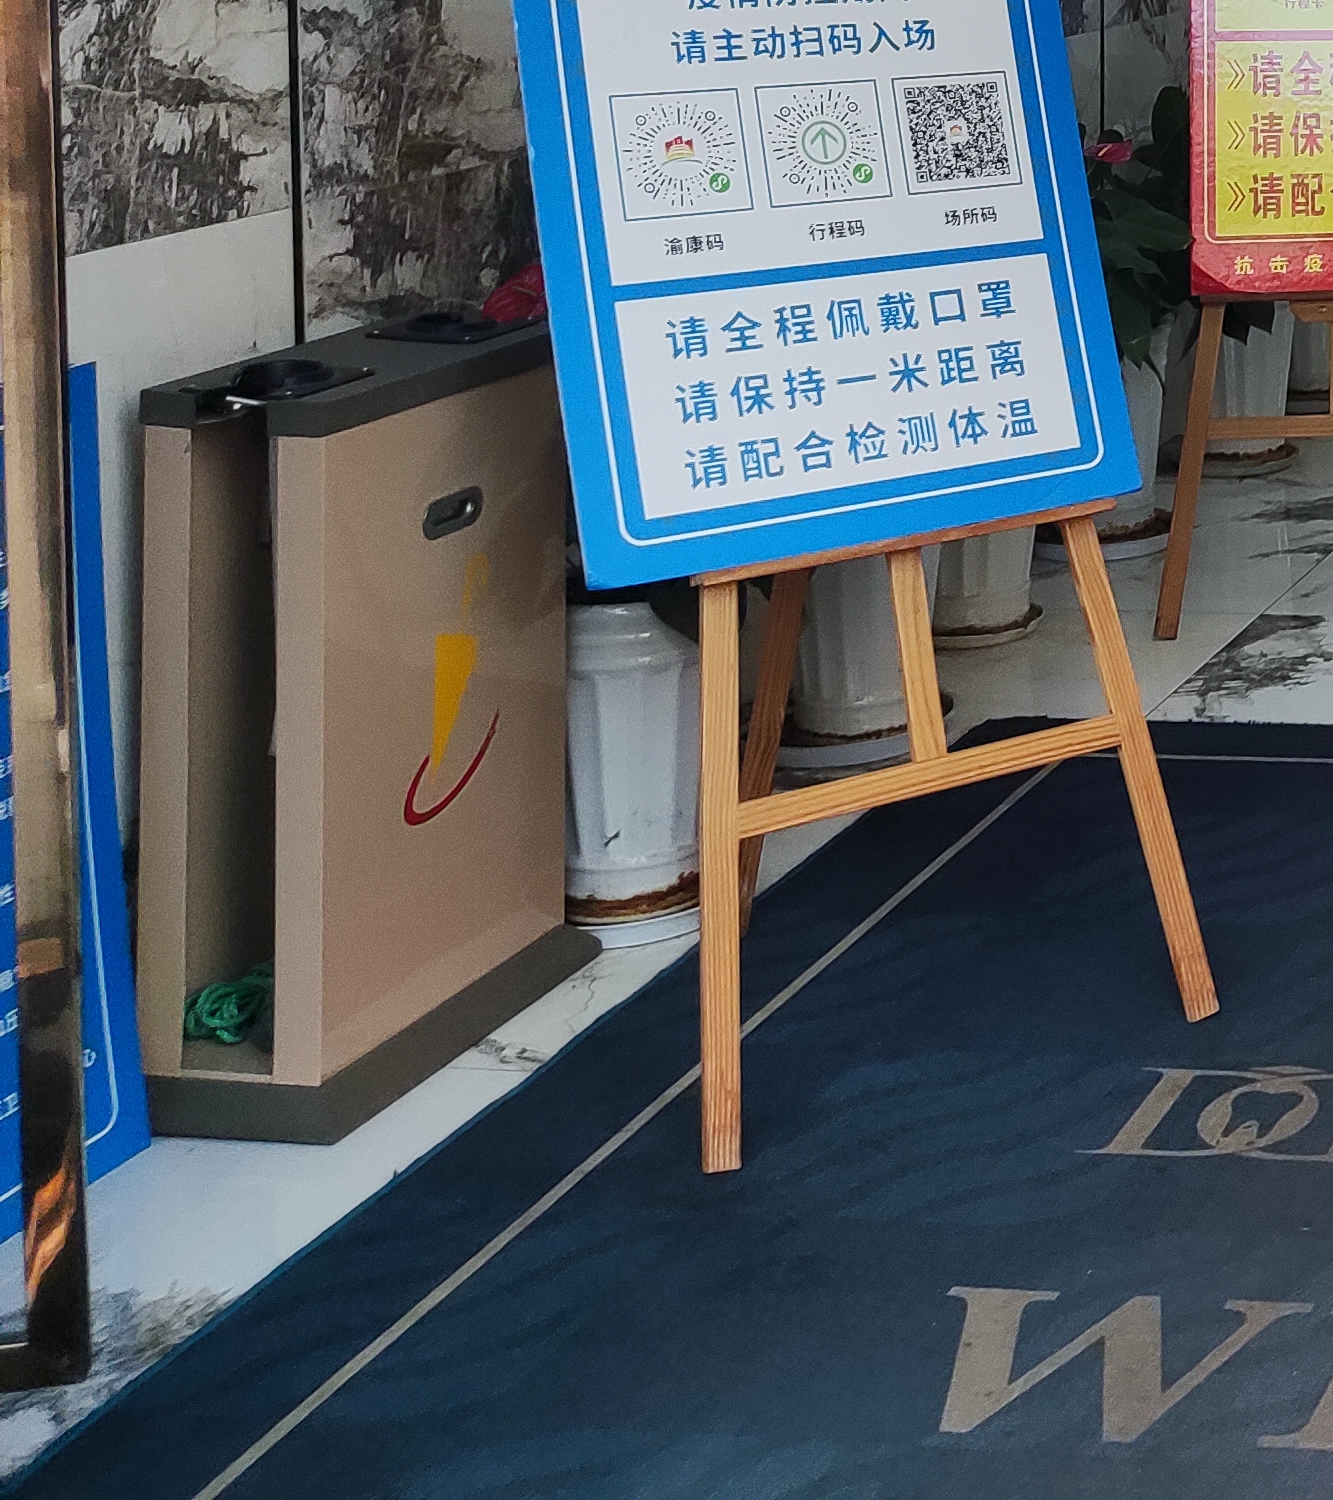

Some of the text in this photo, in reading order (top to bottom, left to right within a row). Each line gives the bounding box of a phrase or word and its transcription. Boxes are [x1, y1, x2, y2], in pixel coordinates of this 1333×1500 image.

[670, 18, 937, 66] 请主动扫码入场
[808, 219, 866, 242] 行程码
[944, 205, 998, 227] 场所码
[664, 233, 725, 257] 渝康码
[666, 280, 1018, 360] 请全程佩戴口罩
[675, 339, 1028, 425] 请保持一米距离
[685, 399, 1039, 491] 请配合检测体温
